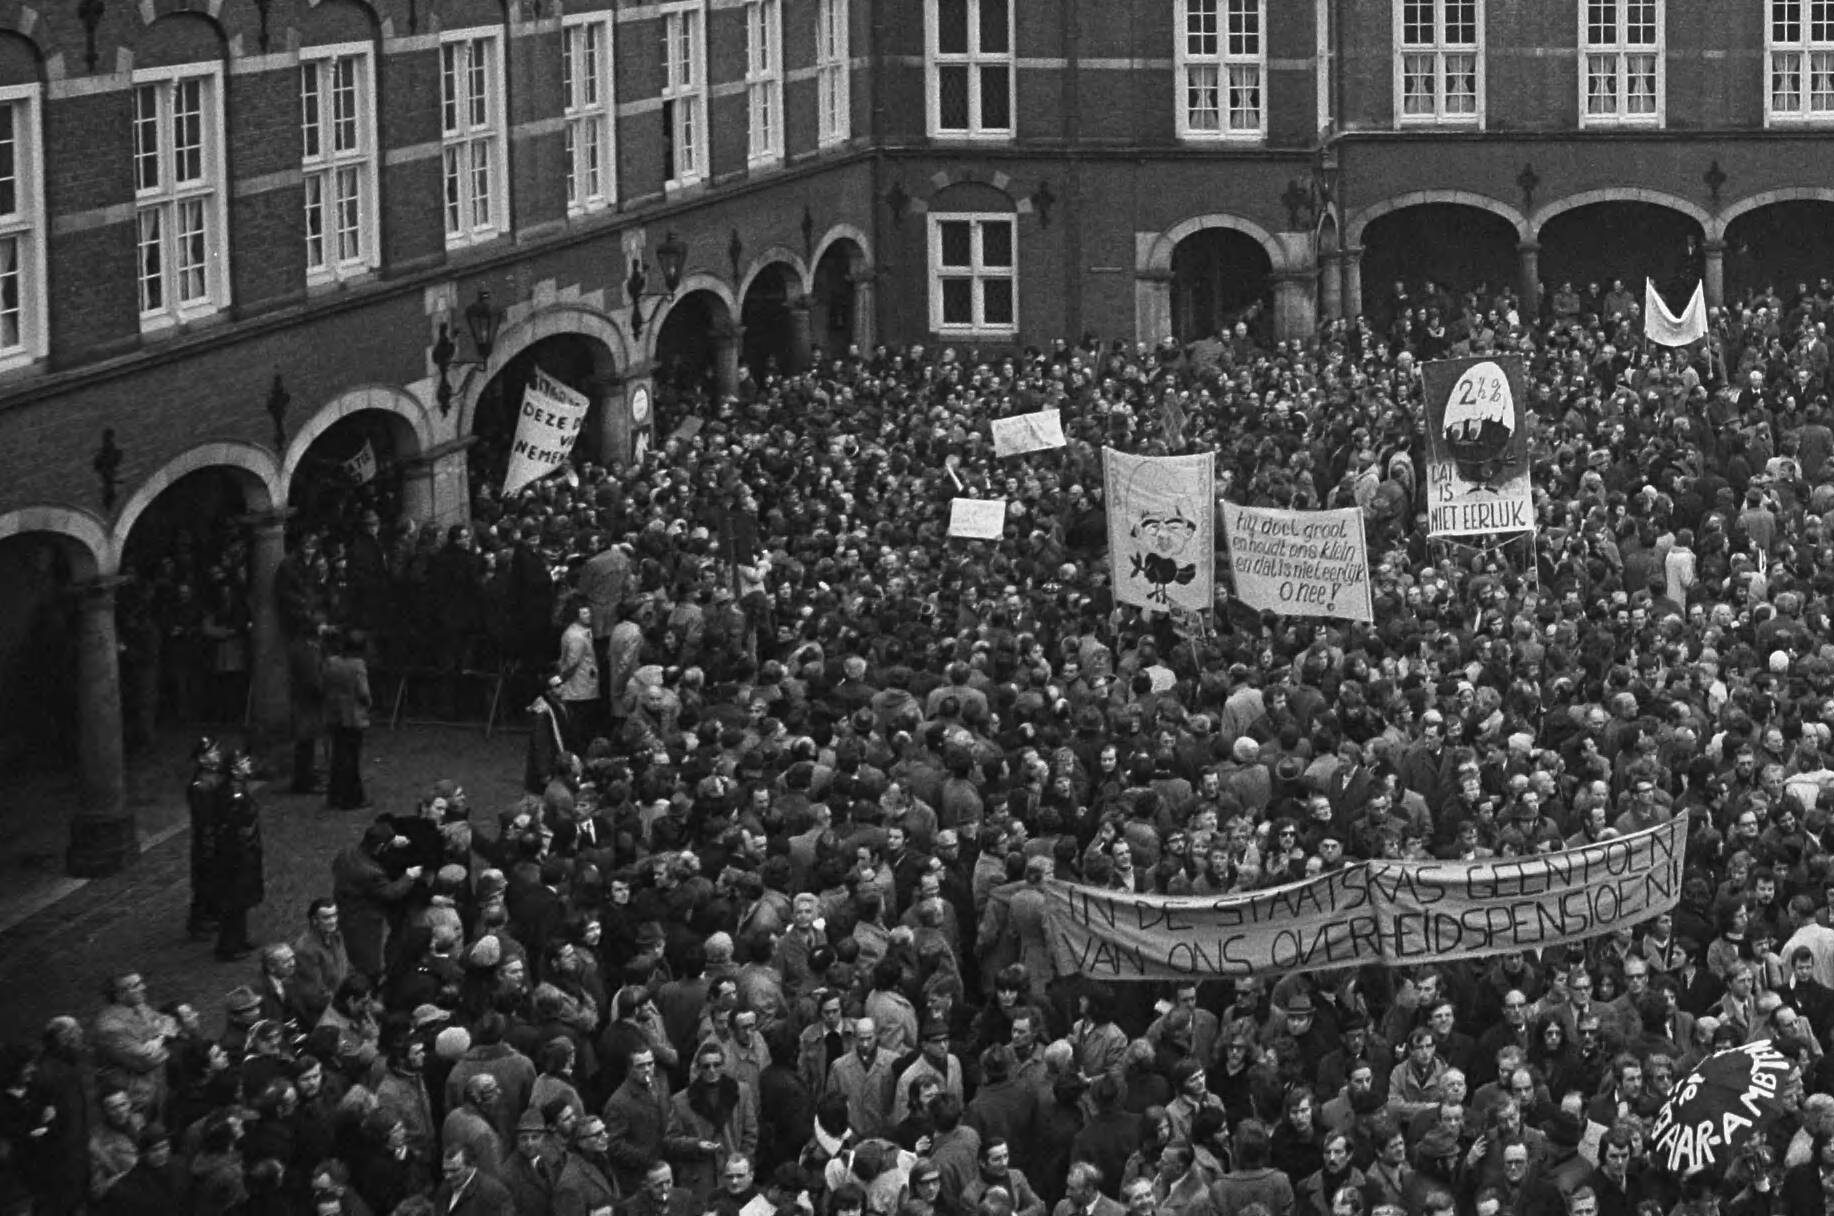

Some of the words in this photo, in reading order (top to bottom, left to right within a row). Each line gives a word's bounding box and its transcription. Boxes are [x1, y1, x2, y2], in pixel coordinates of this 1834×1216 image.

[523, 402, 568, 430] DEZE
[1439, 484, 1453, 501] IS
[1431, 506, 1457, 531] NIET
[1289, 545, 1317, 558] ons
[1320, 541, 1355, 560] klein
[1066, 886, 1116, 929] IN
[1136, 899, 1191, 931] DE
[1216, 862, 1445, 927] STAATSKAS
[1466, 853, 1573, 900] GEEN
[1581, 823, 1677, 884] POEN
[1061, 933, 1146, 976] VAN
[1168, 933, 1253, 976] ONS
[1270, 857, 1680, 964] OVERHEIDSPENSIOEN!
